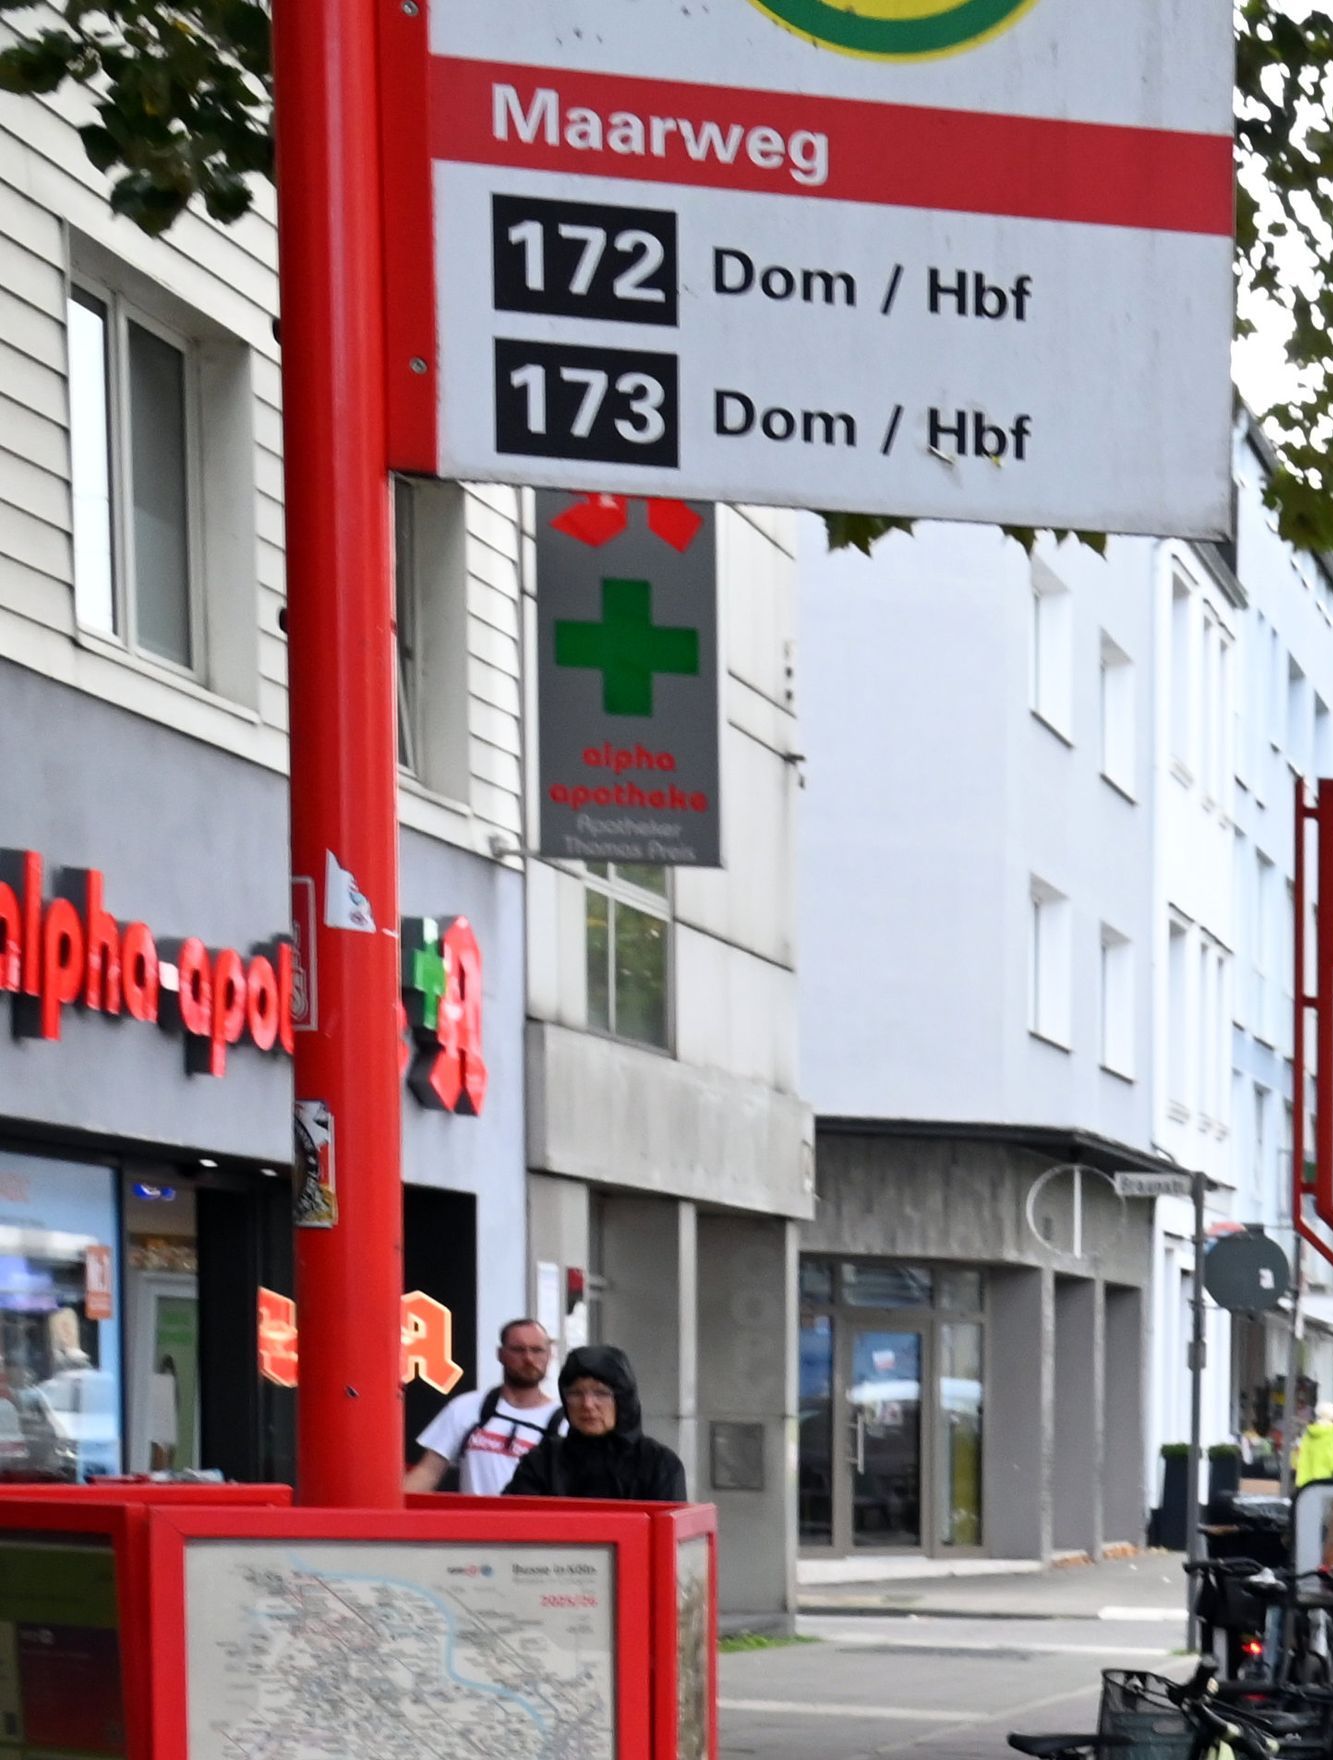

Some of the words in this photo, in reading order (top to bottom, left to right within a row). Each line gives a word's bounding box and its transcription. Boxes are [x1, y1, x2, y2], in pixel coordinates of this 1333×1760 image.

[490, 82, 829, 185] Maarweg
[506, 219, 667, 302] 172
[712, 246, 857, 307] Dom
[926, 266, 1032, 322] Hbf
[508, 362, 667, 445] 173
[713, 388, 857, 447] Dom
[927, 406, 1032, 460] Hbf
[549, 780, 711, 814] apotheke
[581, 740, 678, 775] alpha
